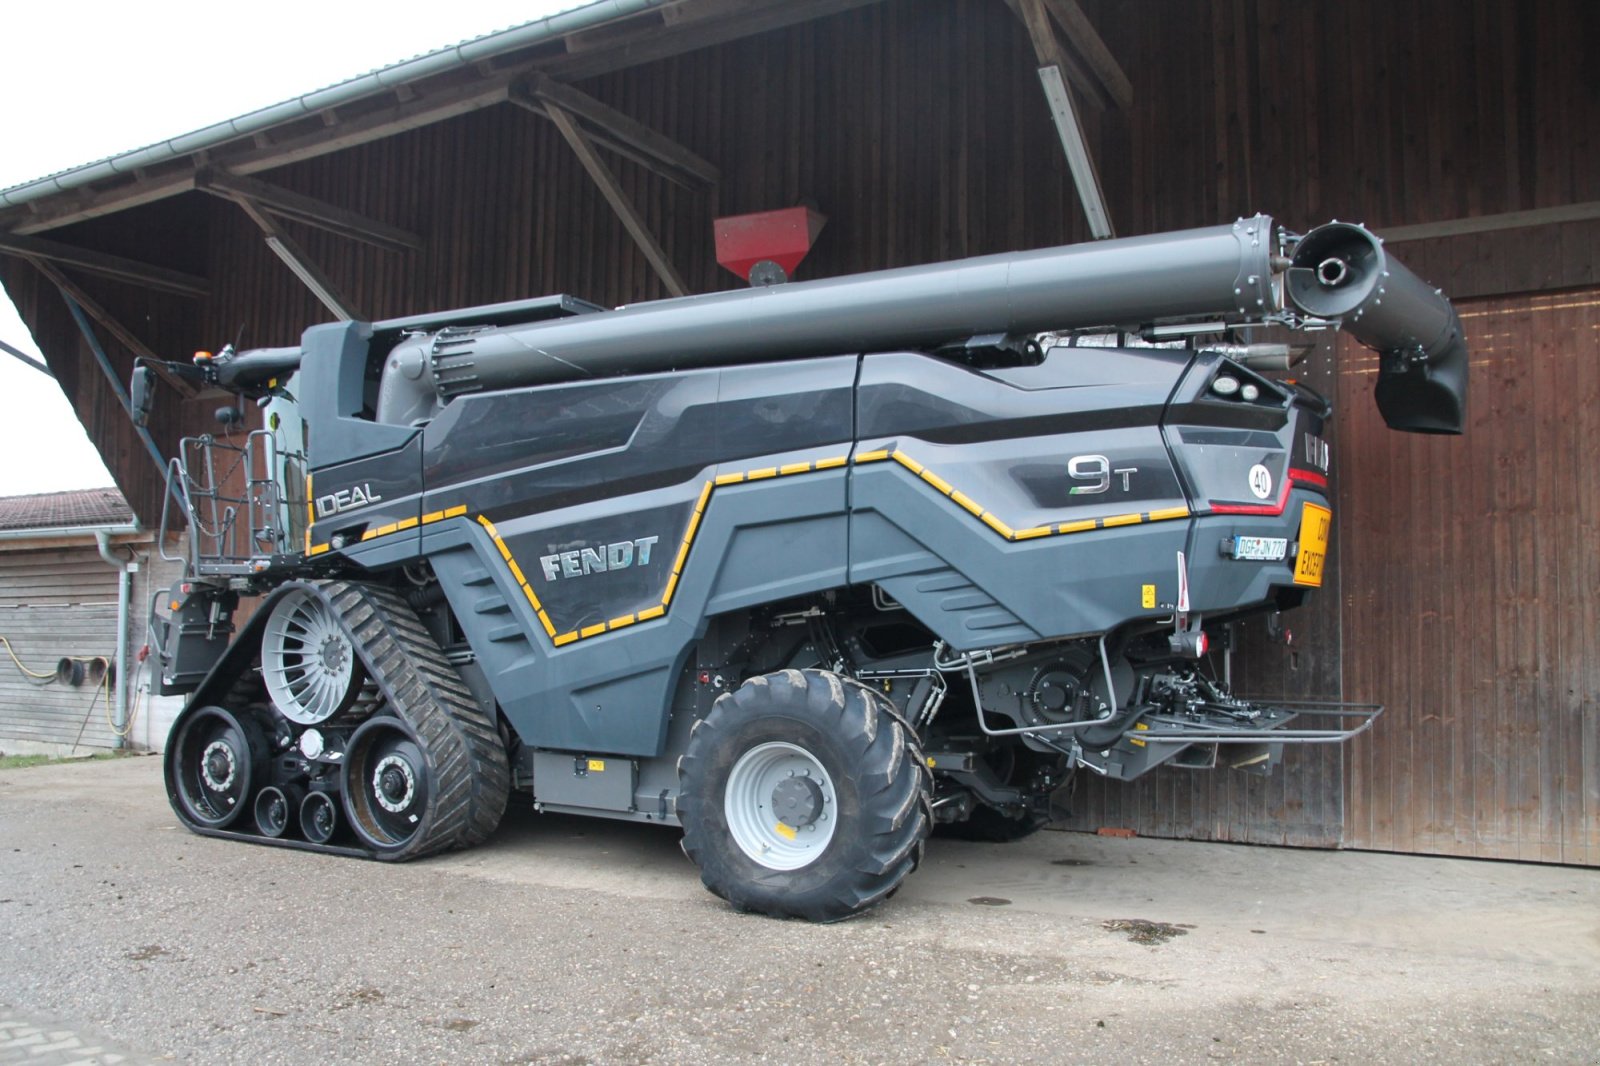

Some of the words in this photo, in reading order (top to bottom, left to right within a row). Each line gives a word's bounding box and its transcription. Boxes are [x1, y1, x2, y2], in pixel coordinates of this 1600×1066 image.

[1254, 471, 1267, 493] 40
[315, 483, 382, 518] IDEAL
[539, 535, 659, 582] FENDT
